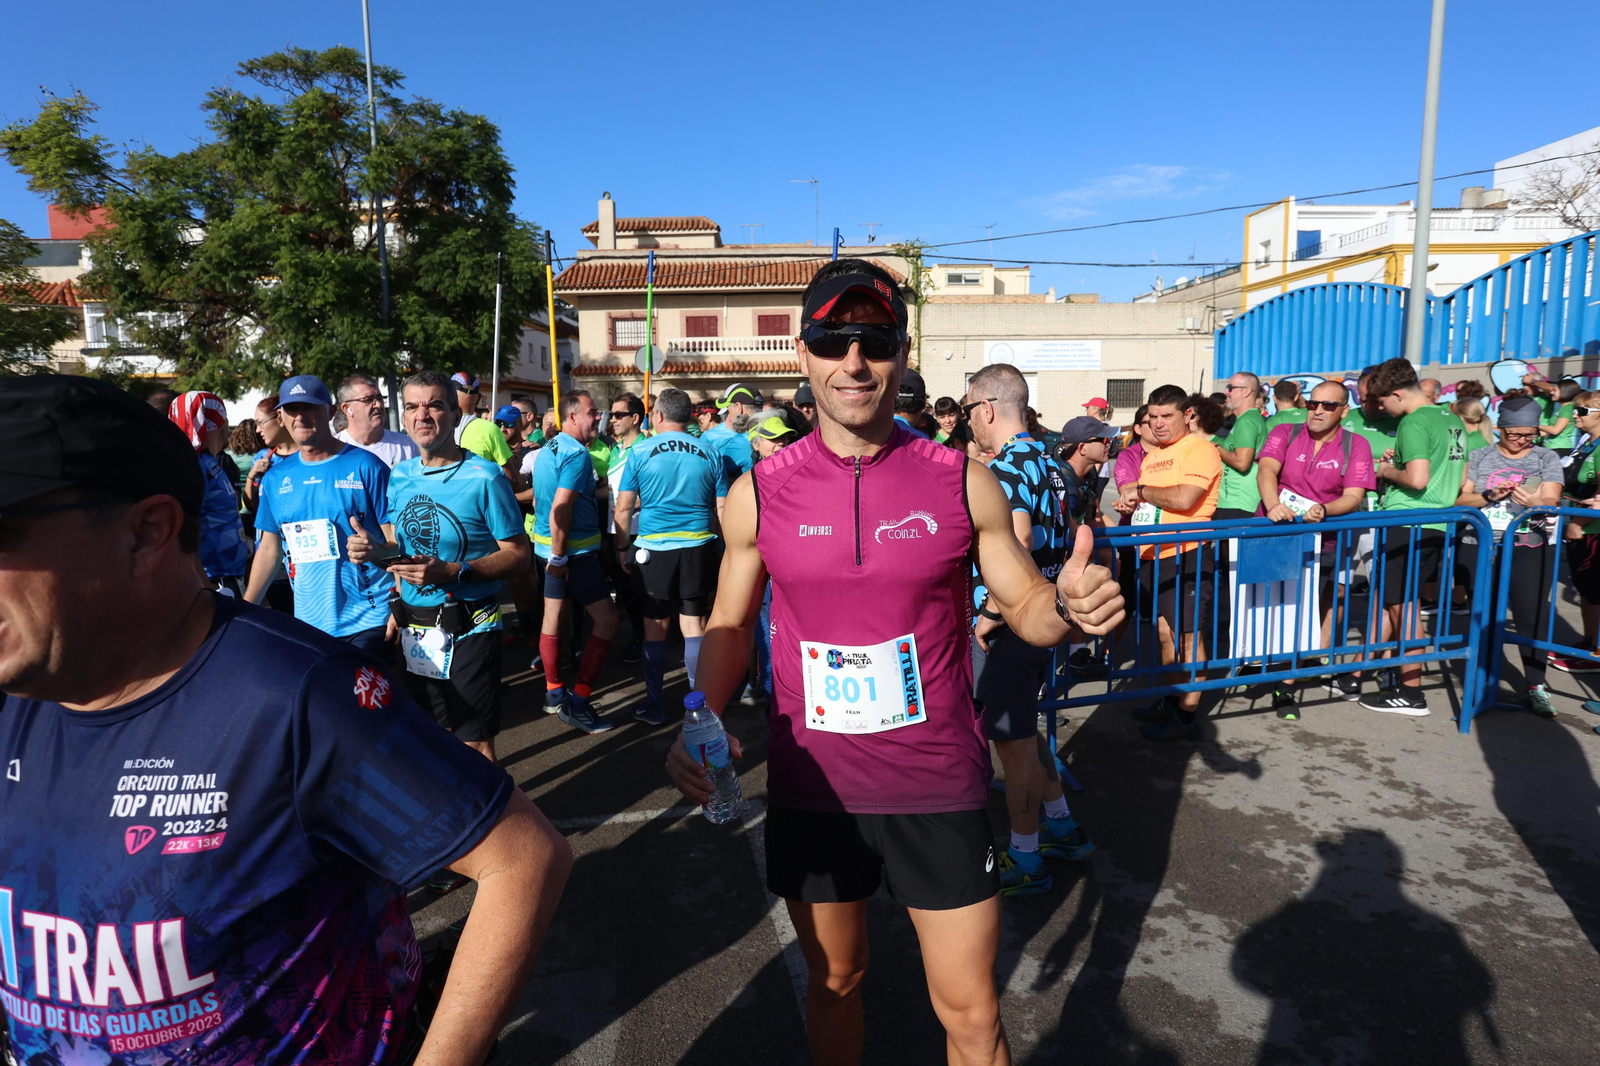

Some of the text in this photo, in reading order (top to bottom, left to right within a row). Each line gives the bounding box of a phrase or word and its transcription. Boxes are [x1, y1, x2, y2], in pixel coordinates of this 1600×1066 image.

[295, 534, 318, 548] 935
[410, 644, 435, 660] 685
[370, 675, 390, 709] TRAIL
[825, 675, 877, 703] 801
[181, 773, 216, 790] TRAIL
[109, 792, 229, 817] TOP RUNNER
[168, 836, 220, 851] 22K 13K
[22, 910, 216, 1008] TRAIL
[46, 1006, 66, 1030] DE
[69, 1010, 101, 1036] LAS
[106, 992, 219, 1036] GUARDAS
[110, 1012, 222, 1052] 15 OCTUBRE 2023
